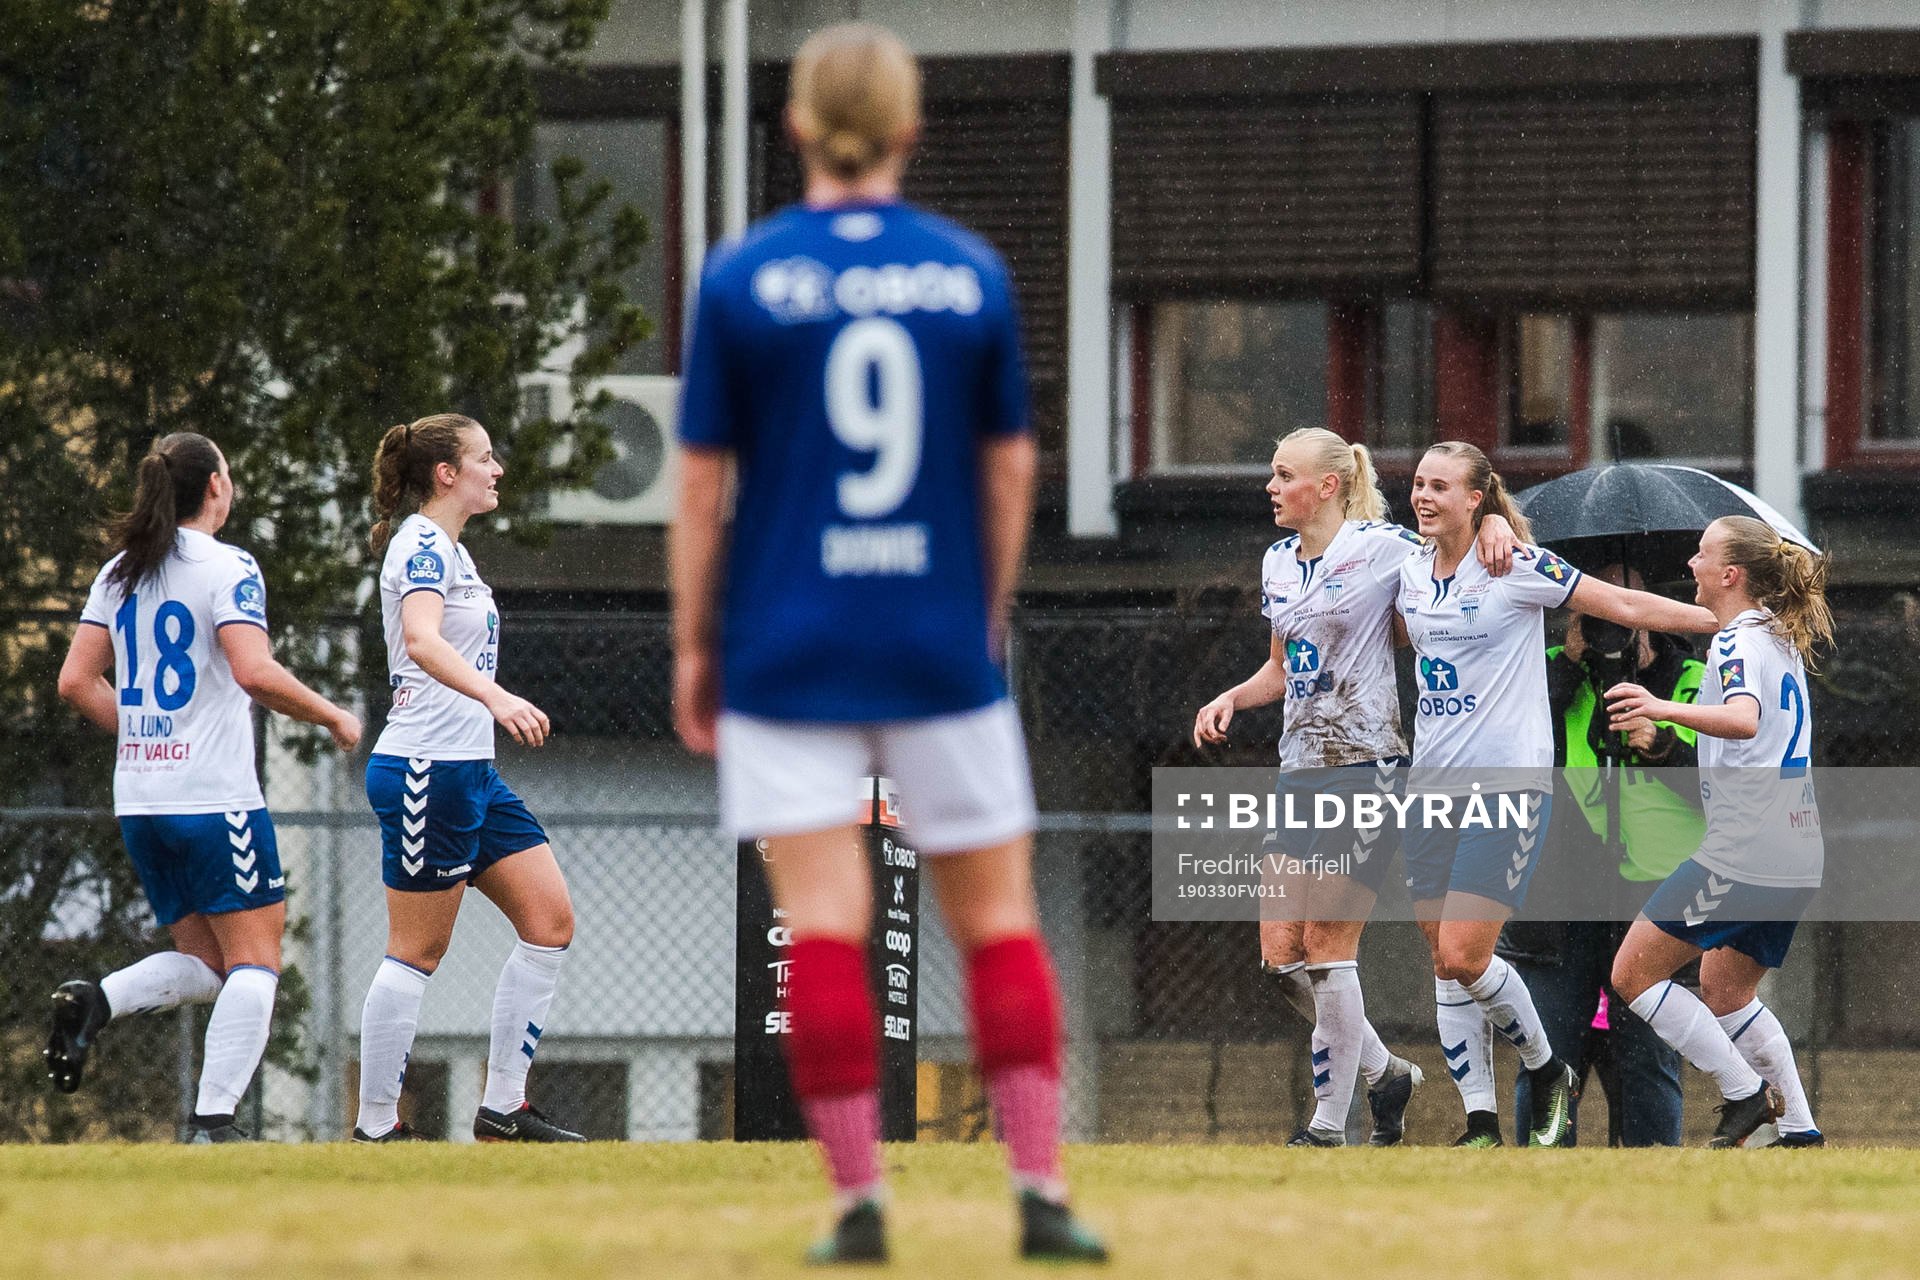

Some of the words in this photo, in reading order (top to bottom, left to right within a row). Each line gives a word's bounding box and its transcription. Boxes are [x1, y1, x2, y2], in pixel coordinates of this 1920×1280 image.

[824, 316, 925, 519] 9
[410, 569, 441, 581] OBOS
[116, 593, 196, 711] 18
[1288, 671, 1334, 699] OBOS
[1419, 695, 1477, 716] OBOS
[140, 714, 173, 738] LUND
[1779, 671, 1808, 780] 2
[144, 742, 190, 761] VALG!
[1789, 811, 1811, 828] MITT
[894, 847, 916, 869] OBOS
[886, 963, 911, 990] THON
[884, 1014, 911, 1041] SELECT
